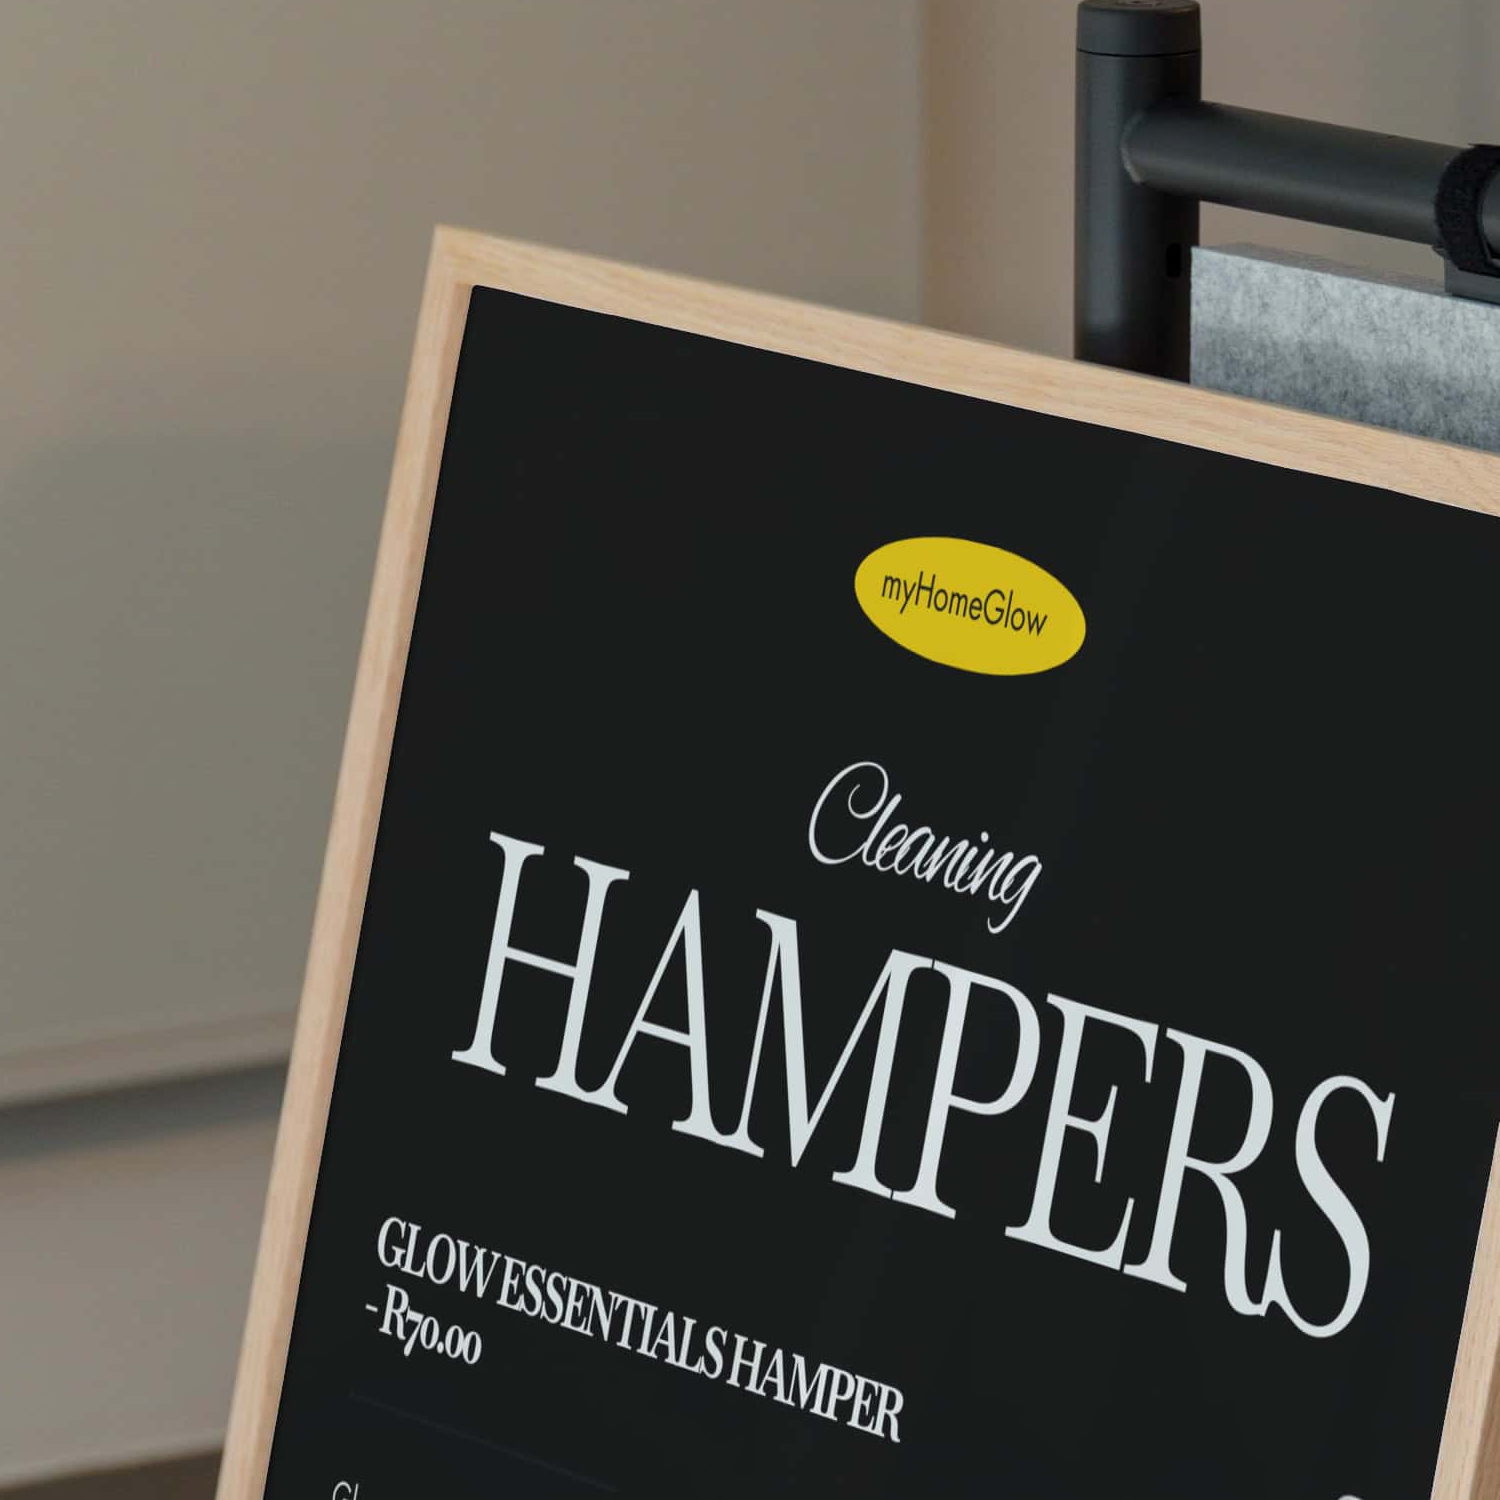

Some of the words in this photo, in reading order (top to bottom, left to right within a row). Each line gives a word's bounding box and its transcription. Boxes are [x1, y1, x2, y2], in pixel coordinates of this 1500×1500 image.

[881, 570, 1049, 636] myHomeGlow
[809, 761, 1042, 934] Cleaning
[452, 831, 1395, 1338] HAMPERS
[378, 1217, 502, 1298] GLOW
[496, 1255, 728, 1379] ESSENTIALS
[726, 1333, 904, 1443] HAMPER
